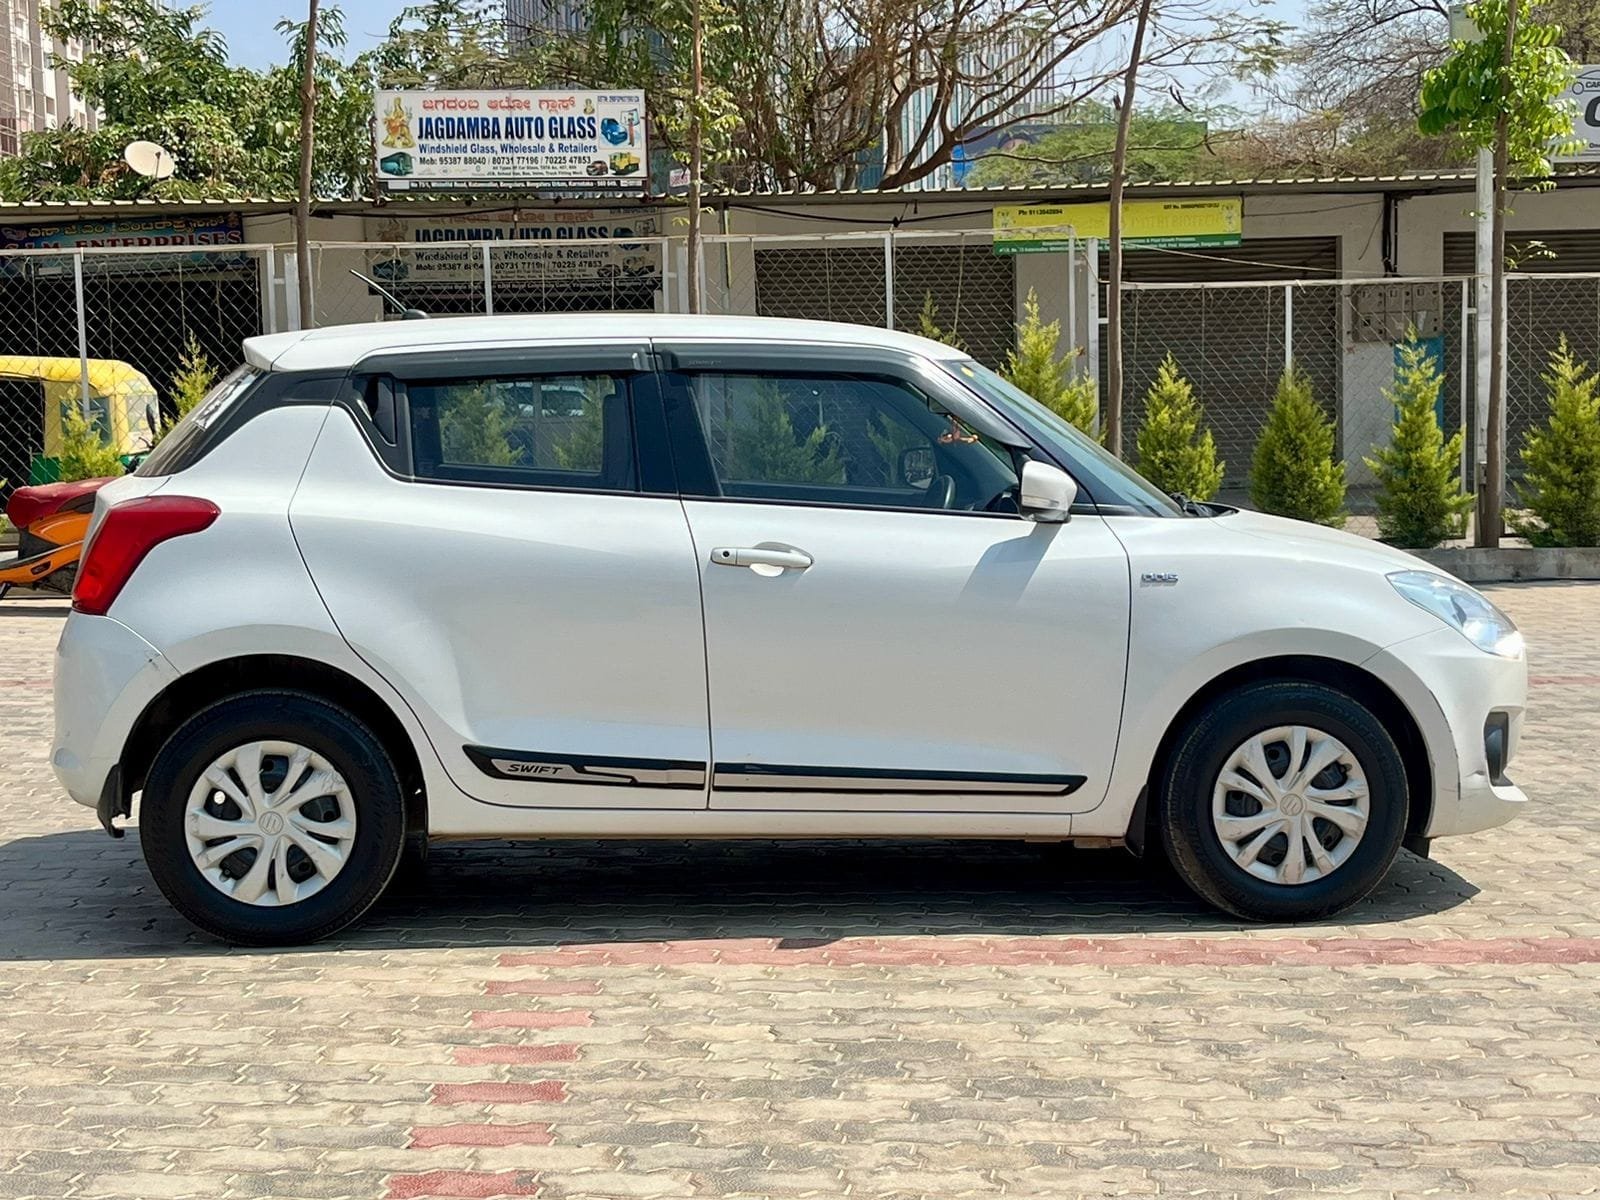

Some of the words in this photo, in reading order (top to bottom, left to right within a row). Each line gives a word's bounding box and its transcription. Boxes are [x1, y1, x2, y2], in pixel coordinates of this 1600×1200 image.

[417, 116, 501, 140] JAGDAMBA
[504, 116, 545, 140] AUTO
[548, 116, 597, 140] GLASS
[418, 143, 468, 154] Windshield
[470, 143, 499, 156] Glass,
[500, 143, 546, 154] Wholesale
[548, 142, 556, 153] &
[558, 143, 598, 153] Retailers
[419, 157, 438, 166] Mob:
[439, 157, 462, 166] 95387
[492, 156, 514, 165] 80731
[516, 156, 539, 165] 77196
[545, 156, 567, 165] 70225
[569, 156, 592, 164] 47853
[507, 763, 563, 775] SWIFT
